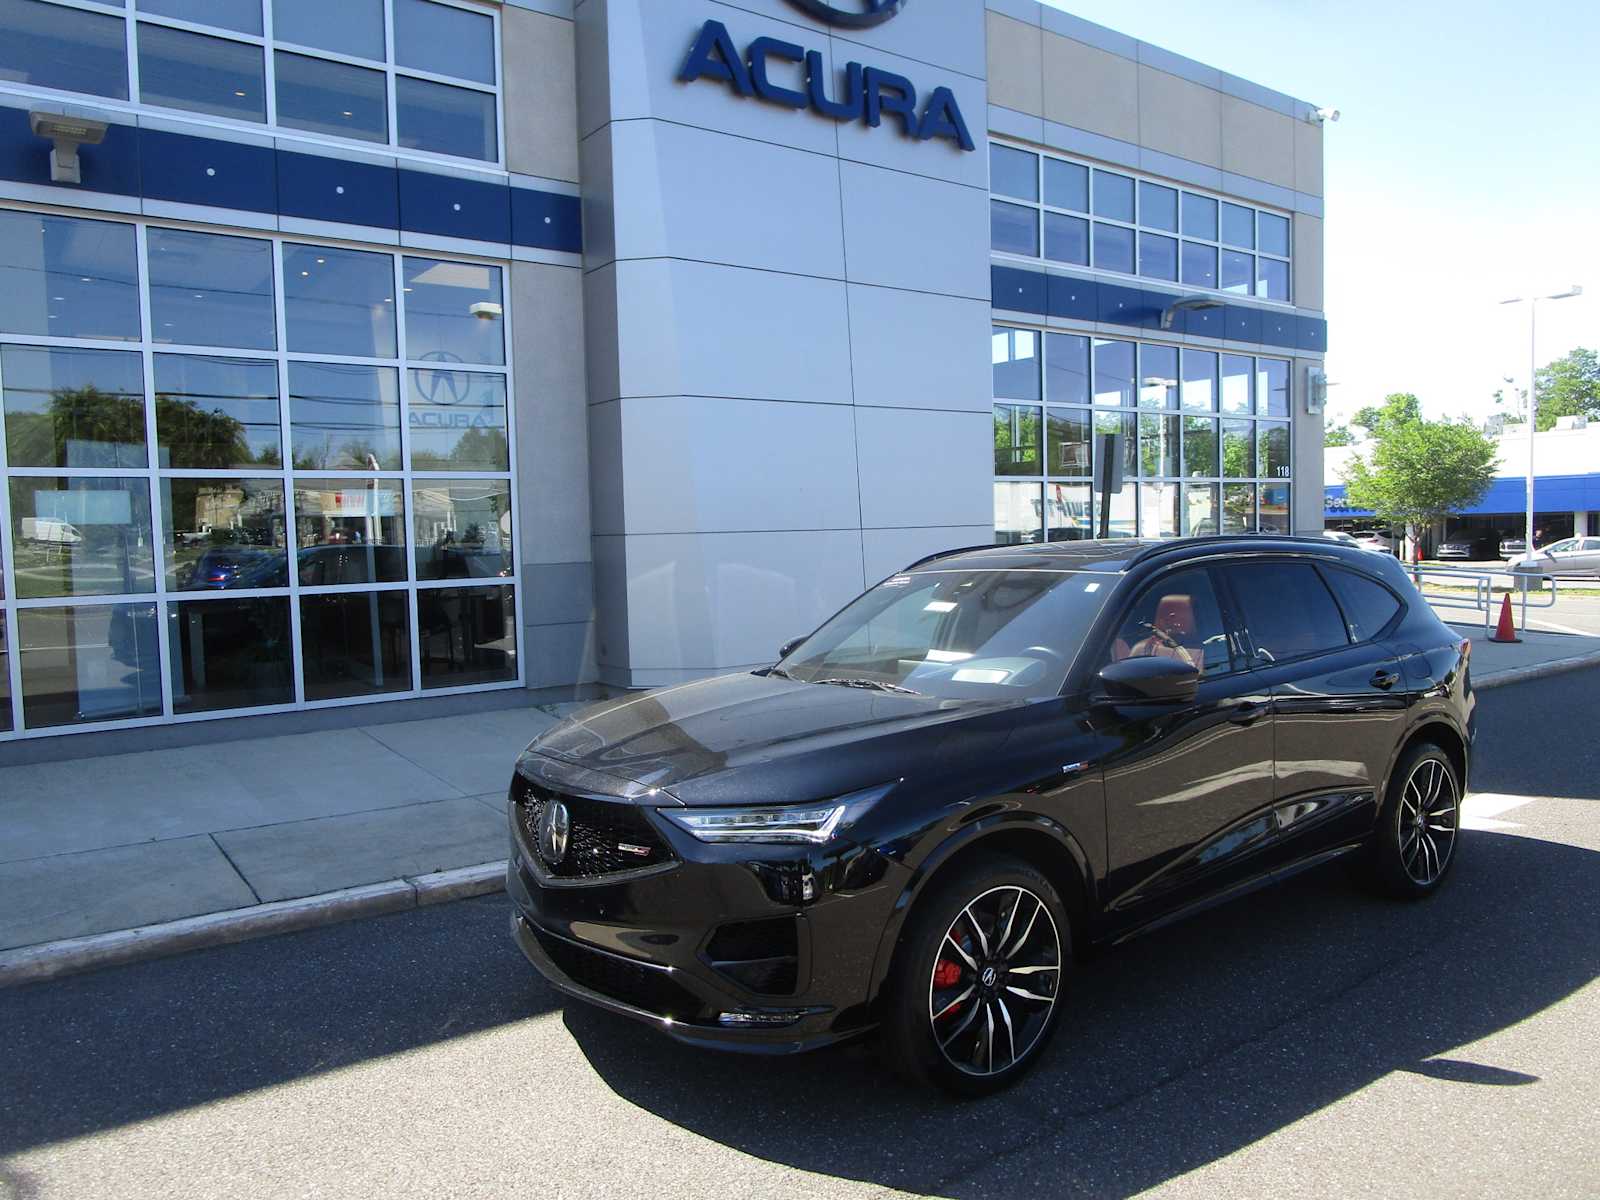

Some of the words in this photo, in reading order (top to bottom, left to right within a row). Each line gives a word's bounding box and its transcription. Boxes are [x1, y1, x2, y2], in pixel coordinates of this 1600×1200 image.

[679, 19, 976, 152] ACURA
[408, 411, 489, 429] ACURA
[1276, 466, 1289, 477] 118
